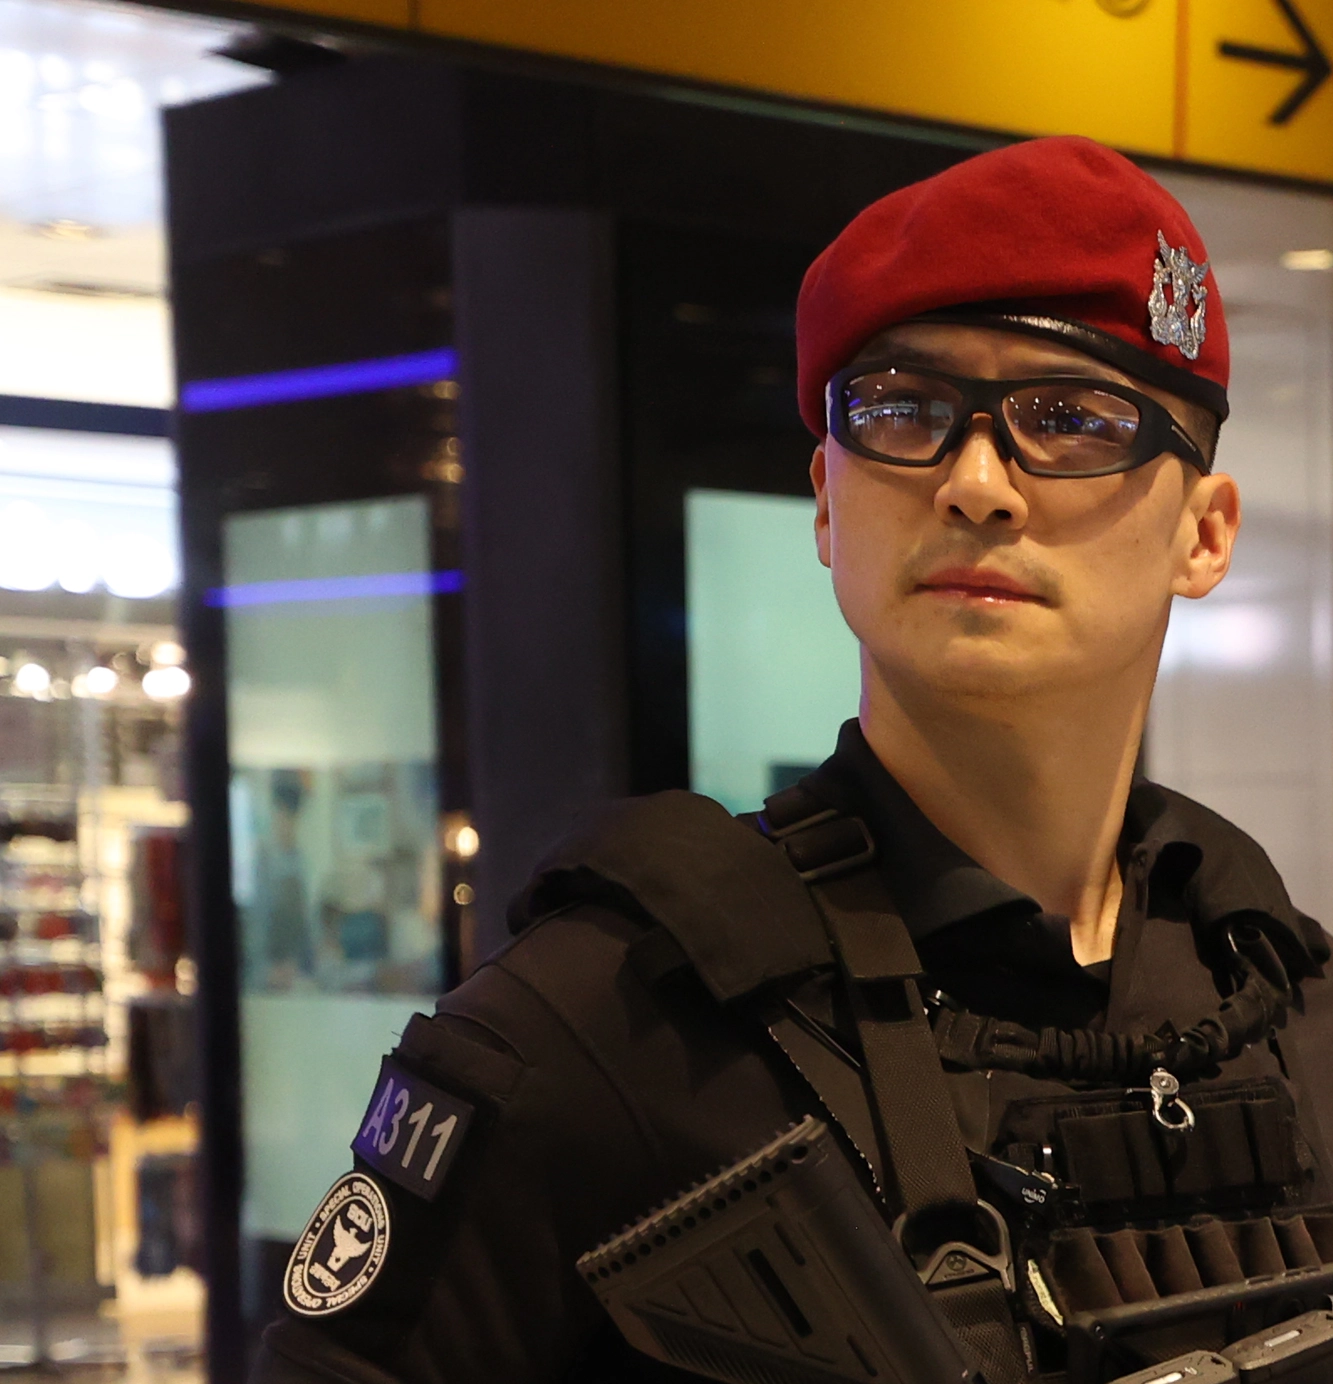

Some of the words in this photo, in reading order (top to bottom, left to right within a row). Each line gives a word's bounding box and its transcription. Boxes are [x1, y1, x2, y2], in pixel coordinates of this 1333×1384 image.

[362, 1077, 458, 1181] A311
[297, 1231, 316, 1260] UNIT
[319, 1184, 351, 1222] SPECIAL
[372, 1234, 386, 1265] UNIT
[325, 1274, 368, 1308] SPECIAL
